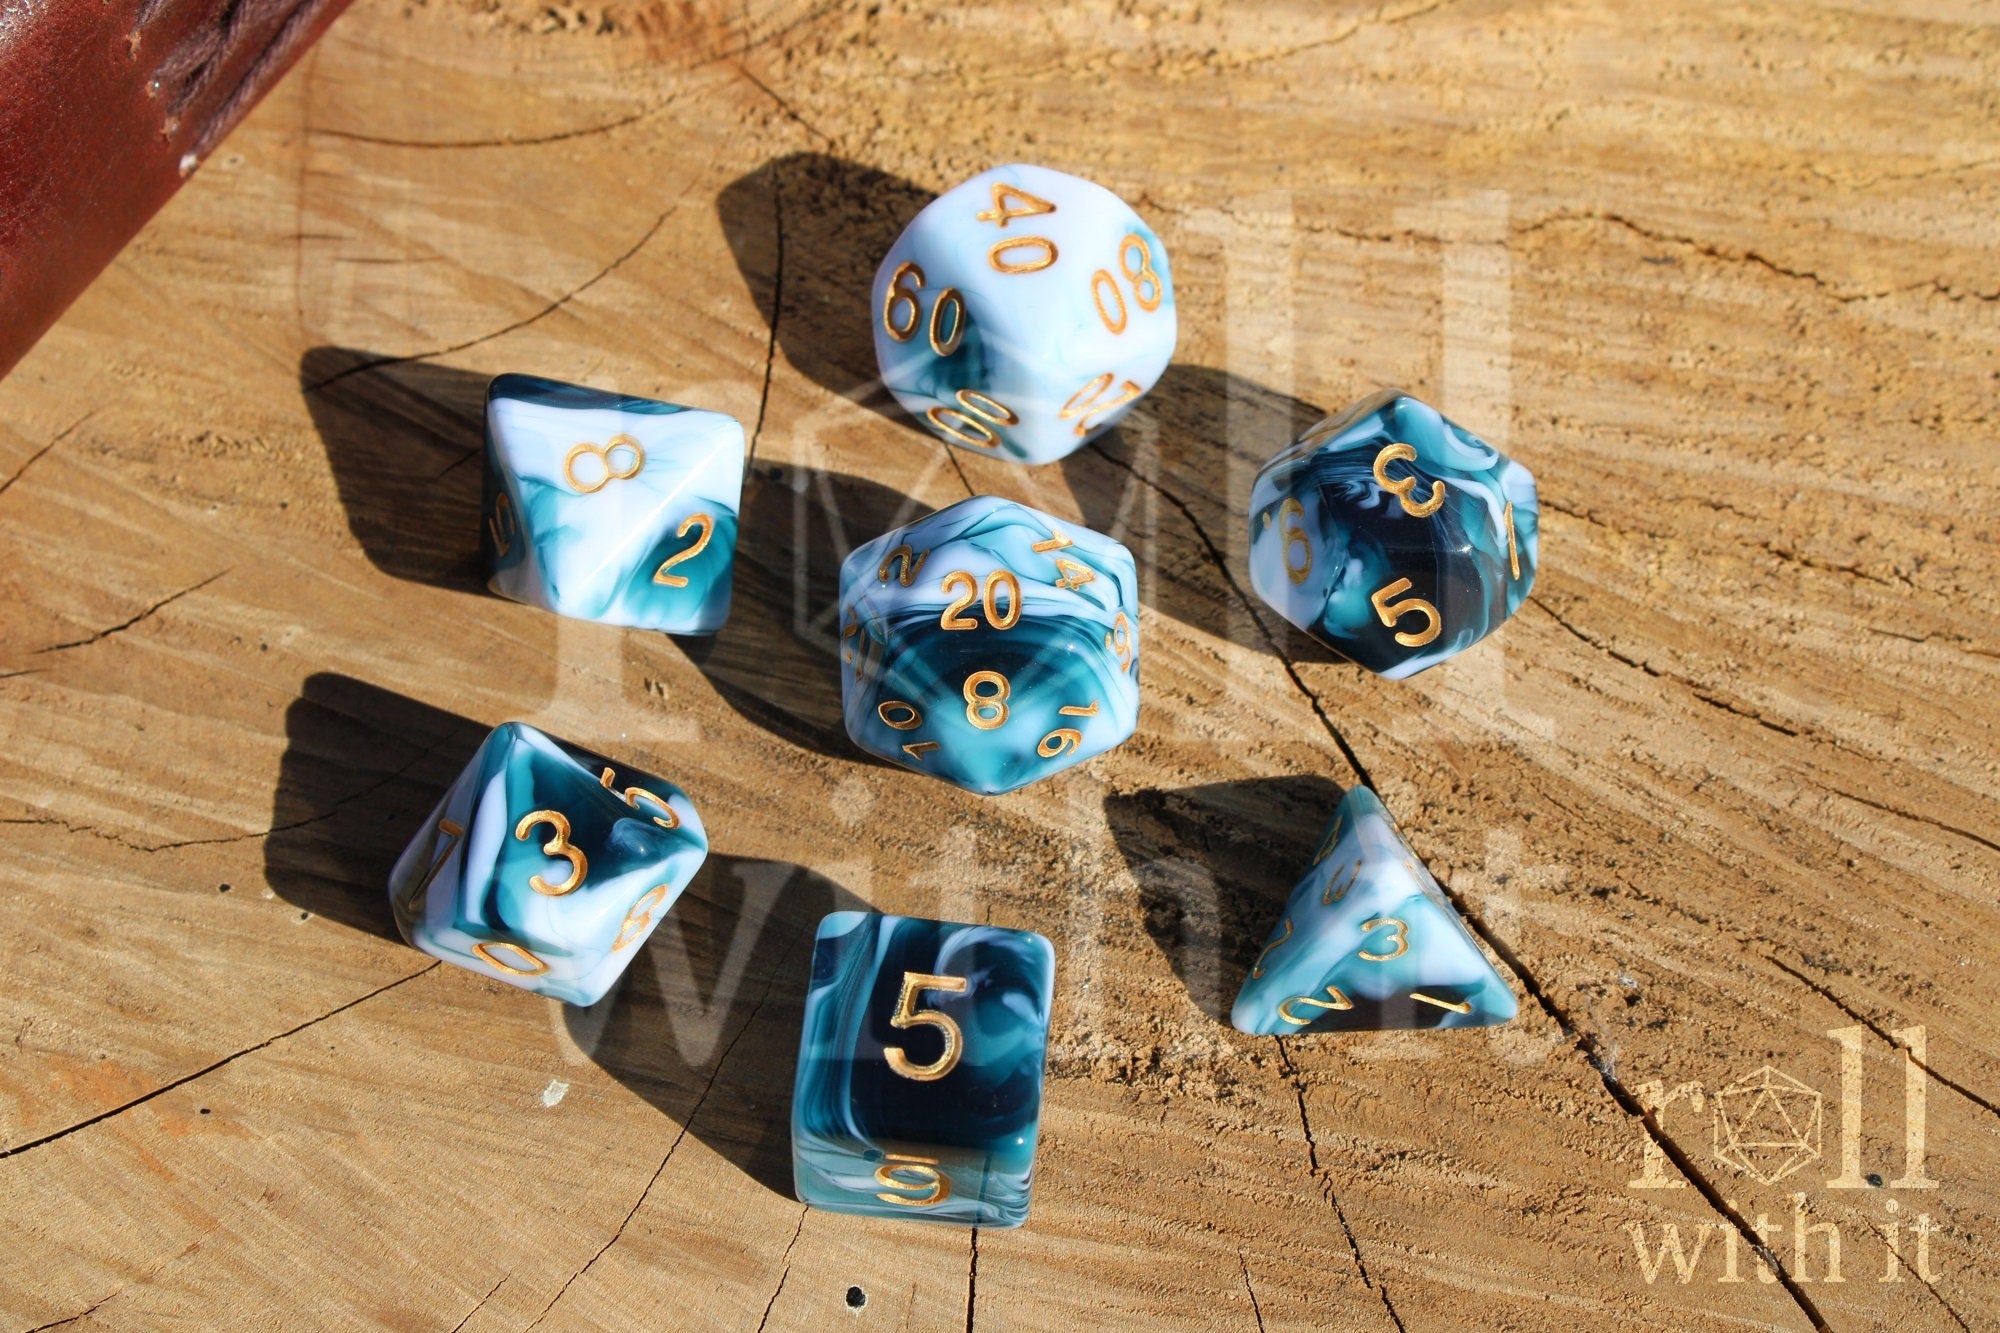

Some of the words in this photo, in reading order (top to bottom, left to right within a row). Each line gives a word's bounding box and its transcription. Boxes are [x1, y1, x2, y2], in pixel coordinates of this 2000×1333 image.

[976, 182, 1059, 274] 40
[884, 261, 966, 356] 60
[564, 433, 646, 494] 8
[1372, 443, 1446, 518] 3
[653, 512, 716, 588] 2
[940, 569, 1022, 631] 20
[1371, 577, 1442, 647] 5
[963, 670, 1011, 730] 8
[600, 767, 681, 829] 5
[515, 810, 588, 896] 3
[471, 942, 548, 977] 0
[1357, 918, 1410, 962] 3
[883, 971, 968, 1082] 5
[1277, 986, 1354, 1025] 2
